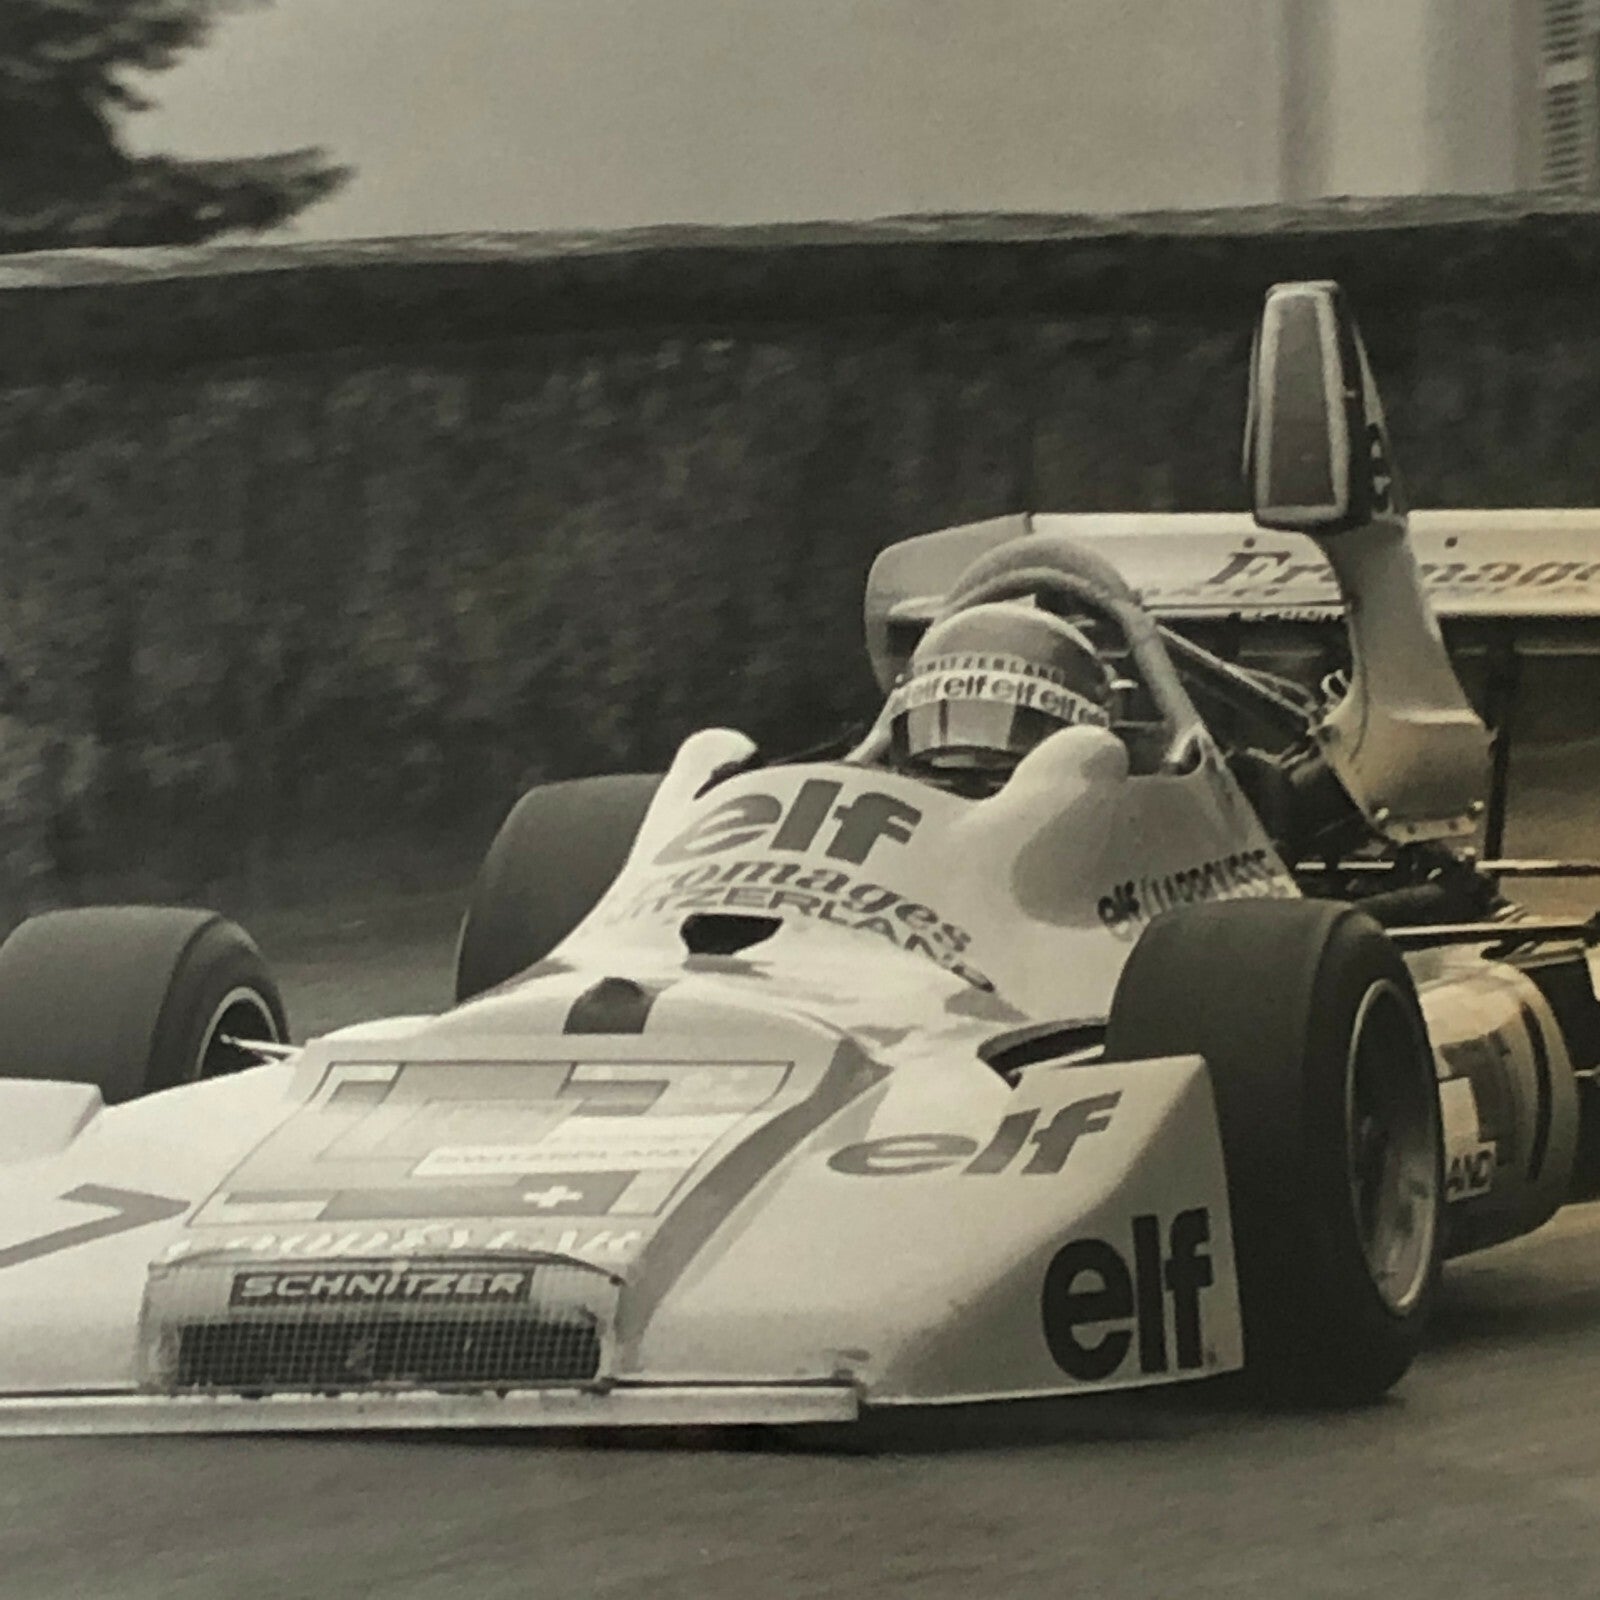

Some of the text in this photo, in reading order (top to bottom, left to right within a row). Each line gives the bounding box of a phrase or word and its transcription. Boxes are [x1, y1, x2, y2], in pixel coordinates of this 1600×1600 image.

[943, 675, 989, 698] elf
[991, 678, 1038, 706] elf
[652, 778, 923, 866] elf
[828, 1090, 1122, 1177] elf
[239, 1273, 525, 1298] SCHNITZER
[1041, 1207, 1214, 1381] elf
